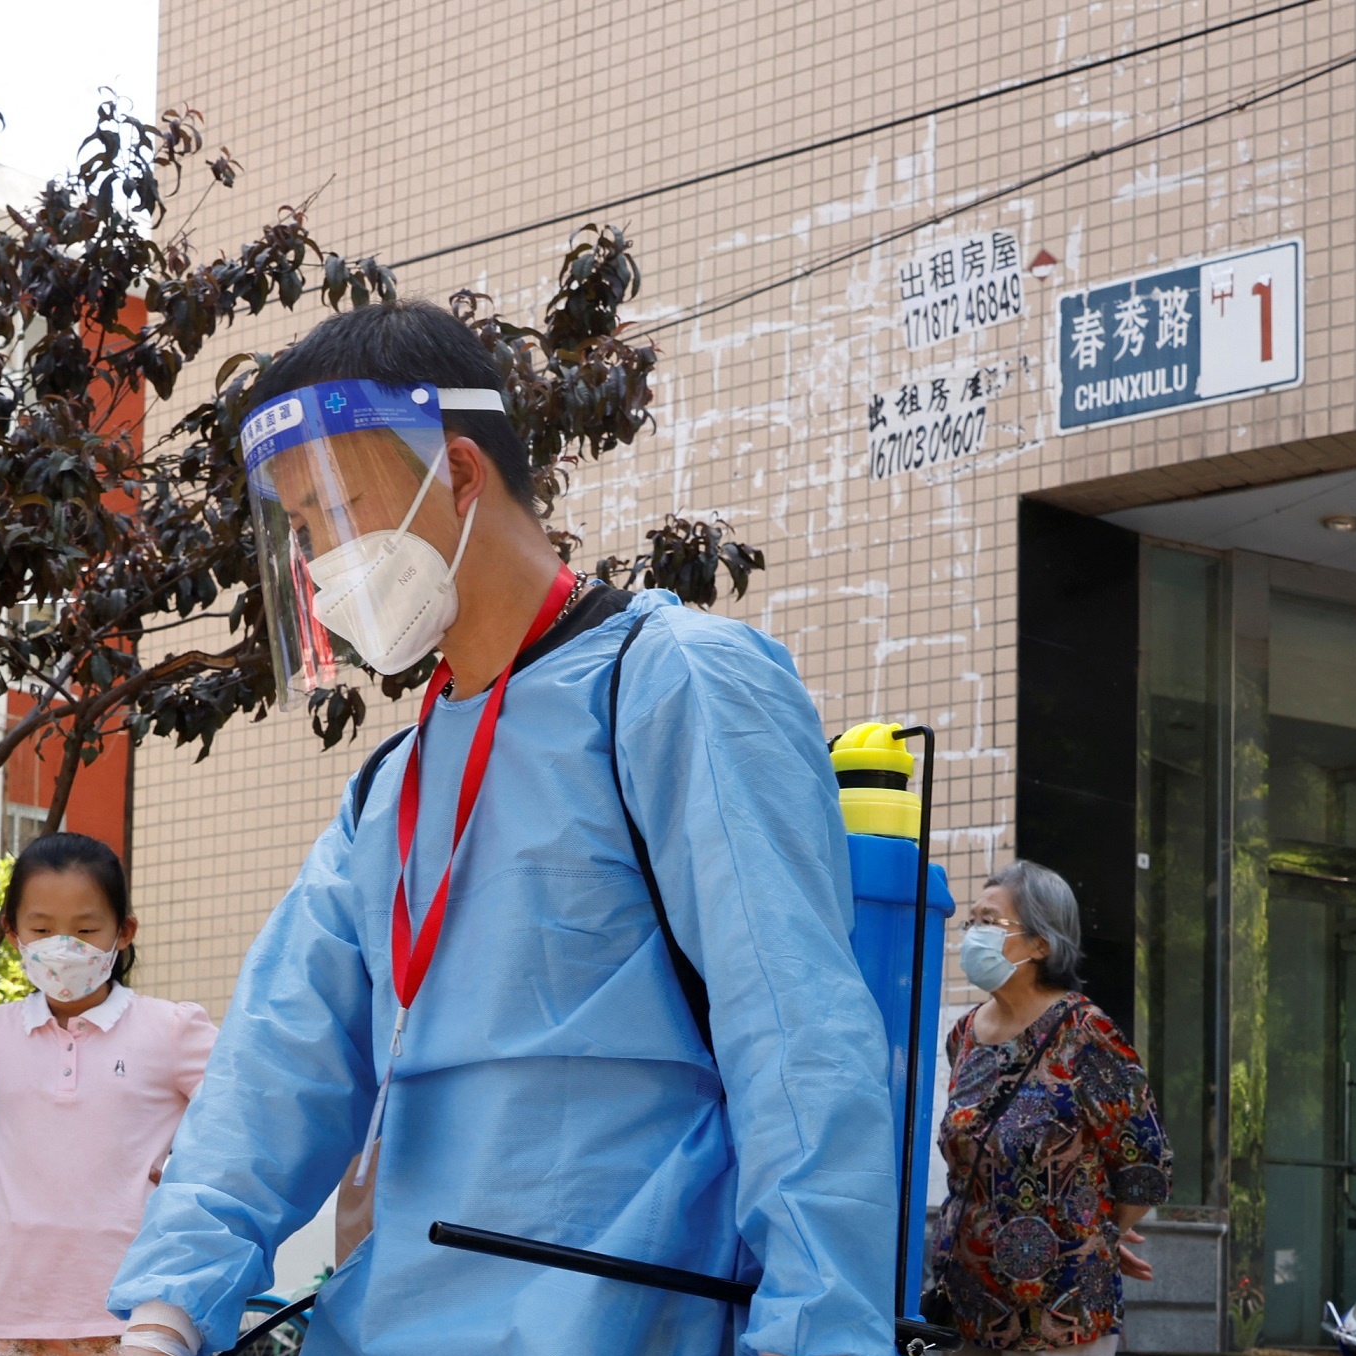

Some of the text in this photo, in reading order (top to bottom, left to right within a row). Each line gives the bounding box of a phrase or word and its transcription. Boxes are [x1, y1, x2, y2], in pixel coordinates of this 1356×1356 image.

[900, 232, 1016, 301] 出租房屋
[1069, 287, 1194, 370] 春秀路
[1251, 274, 1273, 362] 1
[1074, 363, 1188, 412] CHUNXIULU
[397, 566, 417, 586] N95
